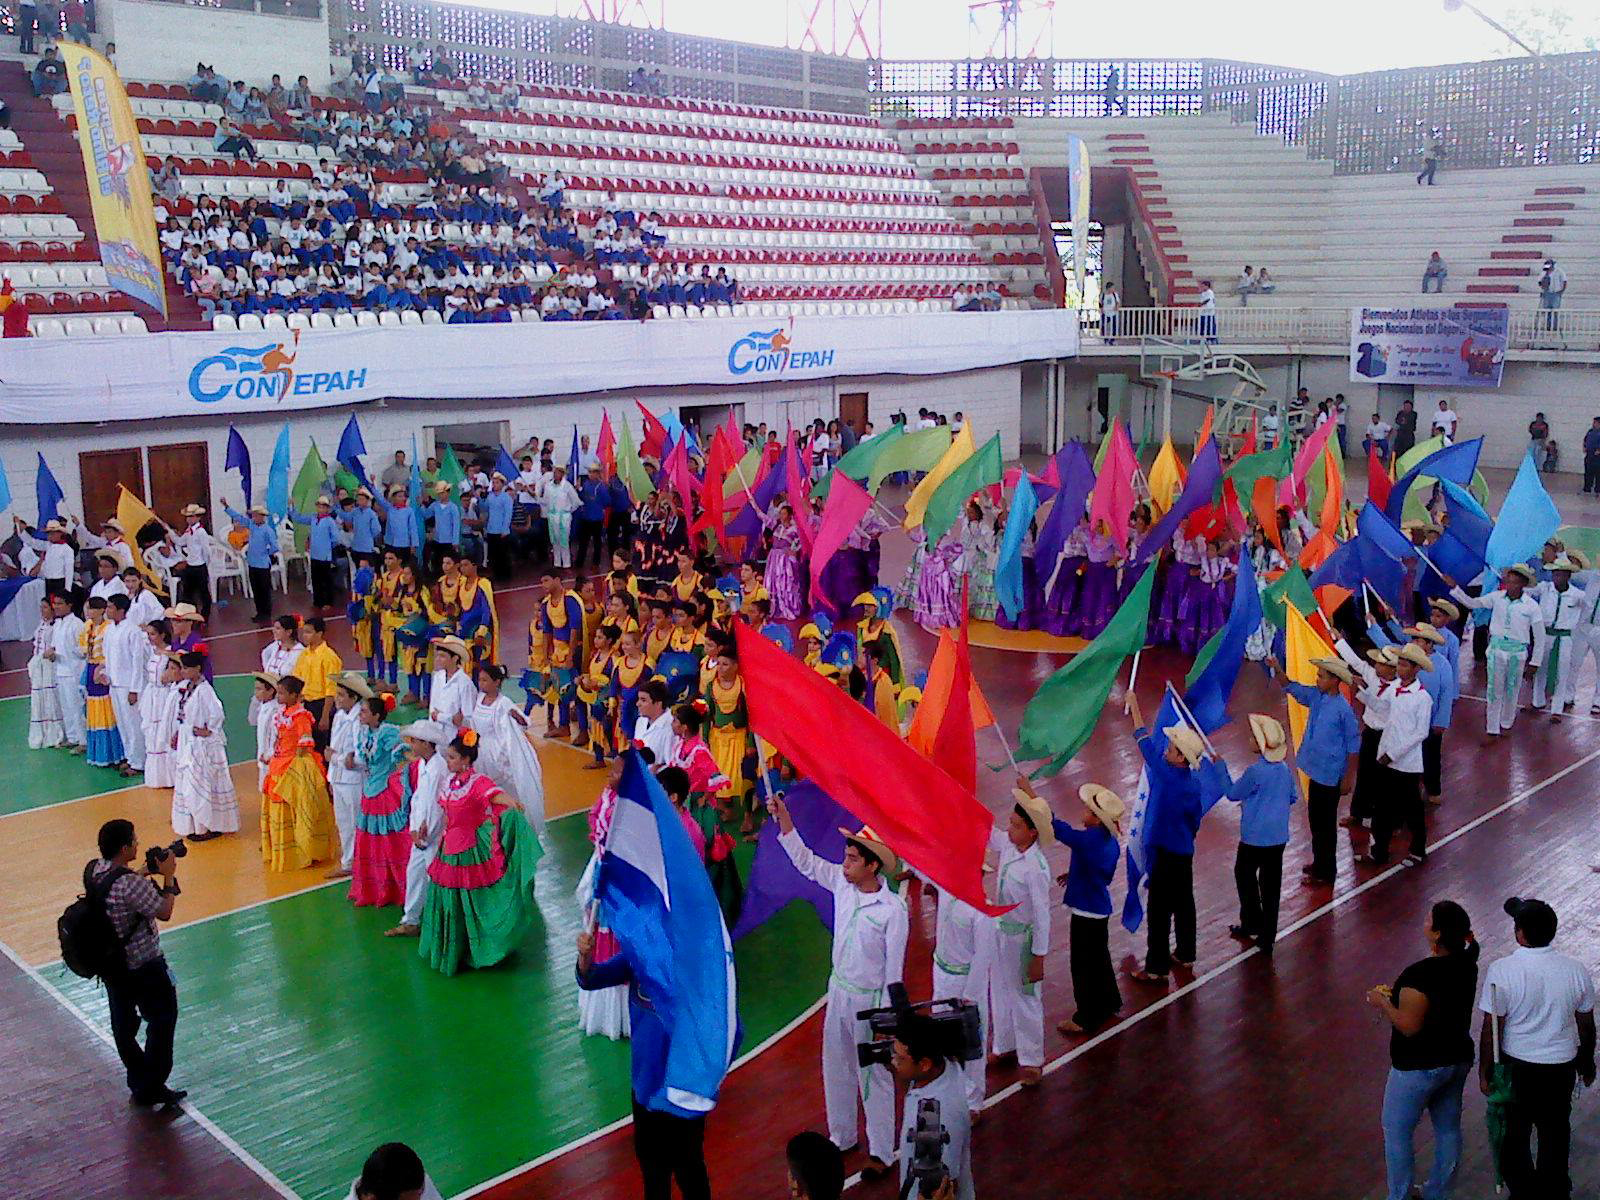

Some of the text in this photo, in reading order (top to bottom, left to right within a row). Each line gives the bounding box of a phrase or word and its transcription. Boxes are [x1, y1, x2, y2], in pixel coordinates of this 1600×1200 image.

[1362, 308, 1408, 320] Bienvenidos
[1411, 308, 1439, 320] Atletas
[1360, 321, 1383, 336] Juegos
[1386, 321, 1424, 334] Nacionales
[1425, 322, 1437, 334] del
